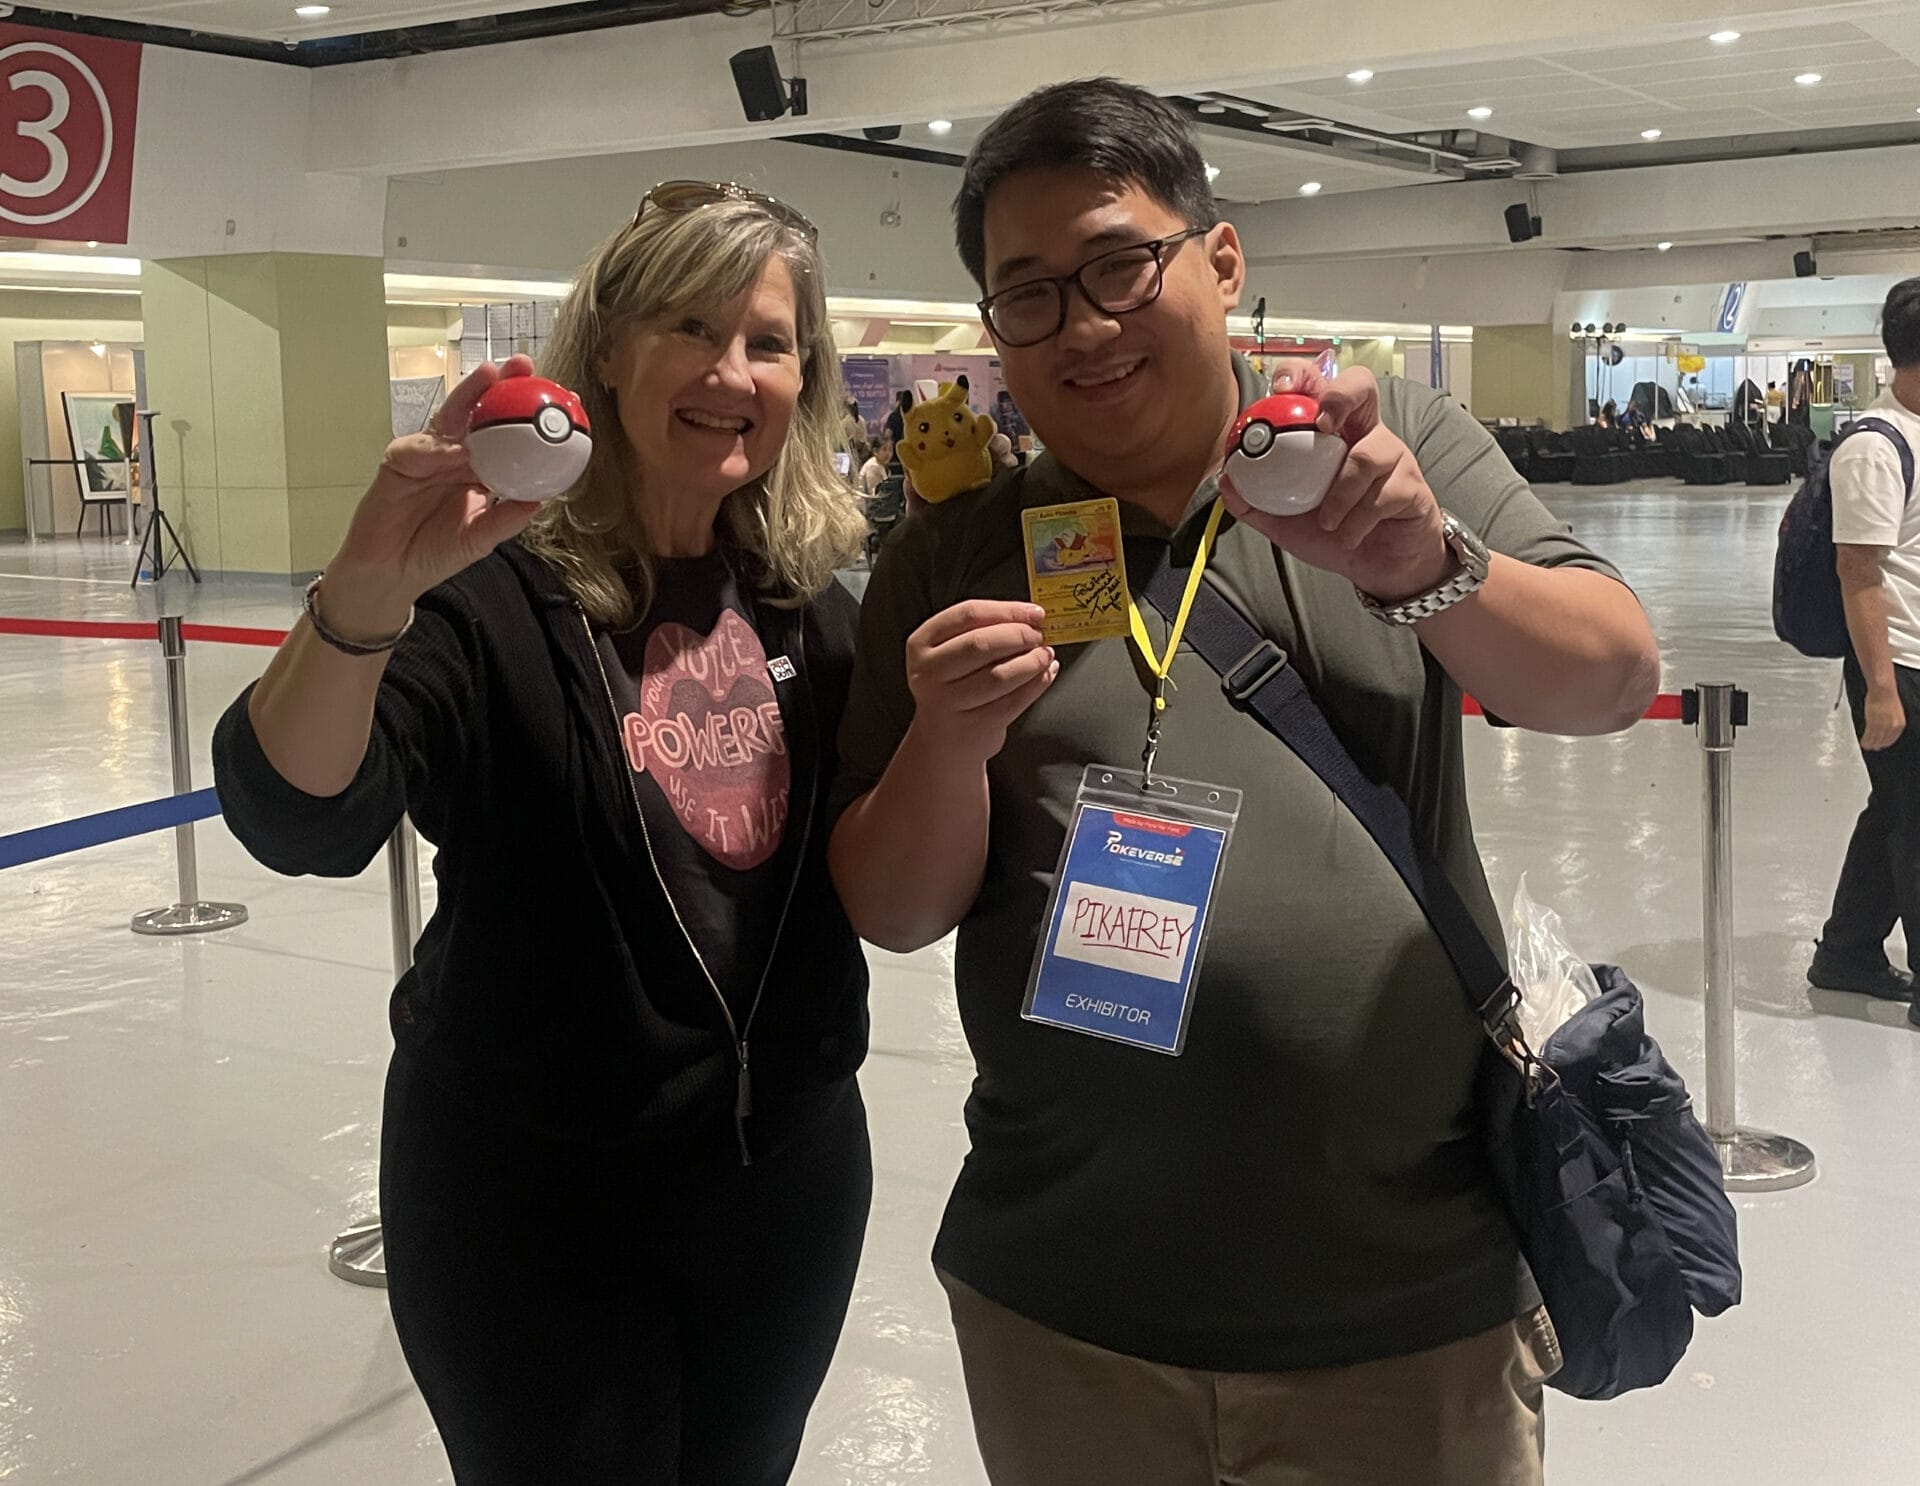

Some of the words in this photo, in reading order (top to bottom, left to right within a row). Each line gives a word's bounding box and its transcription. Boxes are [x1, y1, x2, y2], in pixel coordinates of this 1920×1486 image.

[0, 70, 70, 198] 3
[659, 619, 755, 696] VOICE
[705, 808, 729, 853] IT
[1073, 897, 1194, 957] PIKAFREY
[1065, 993, 1152, 1026] EXHIBITOR
